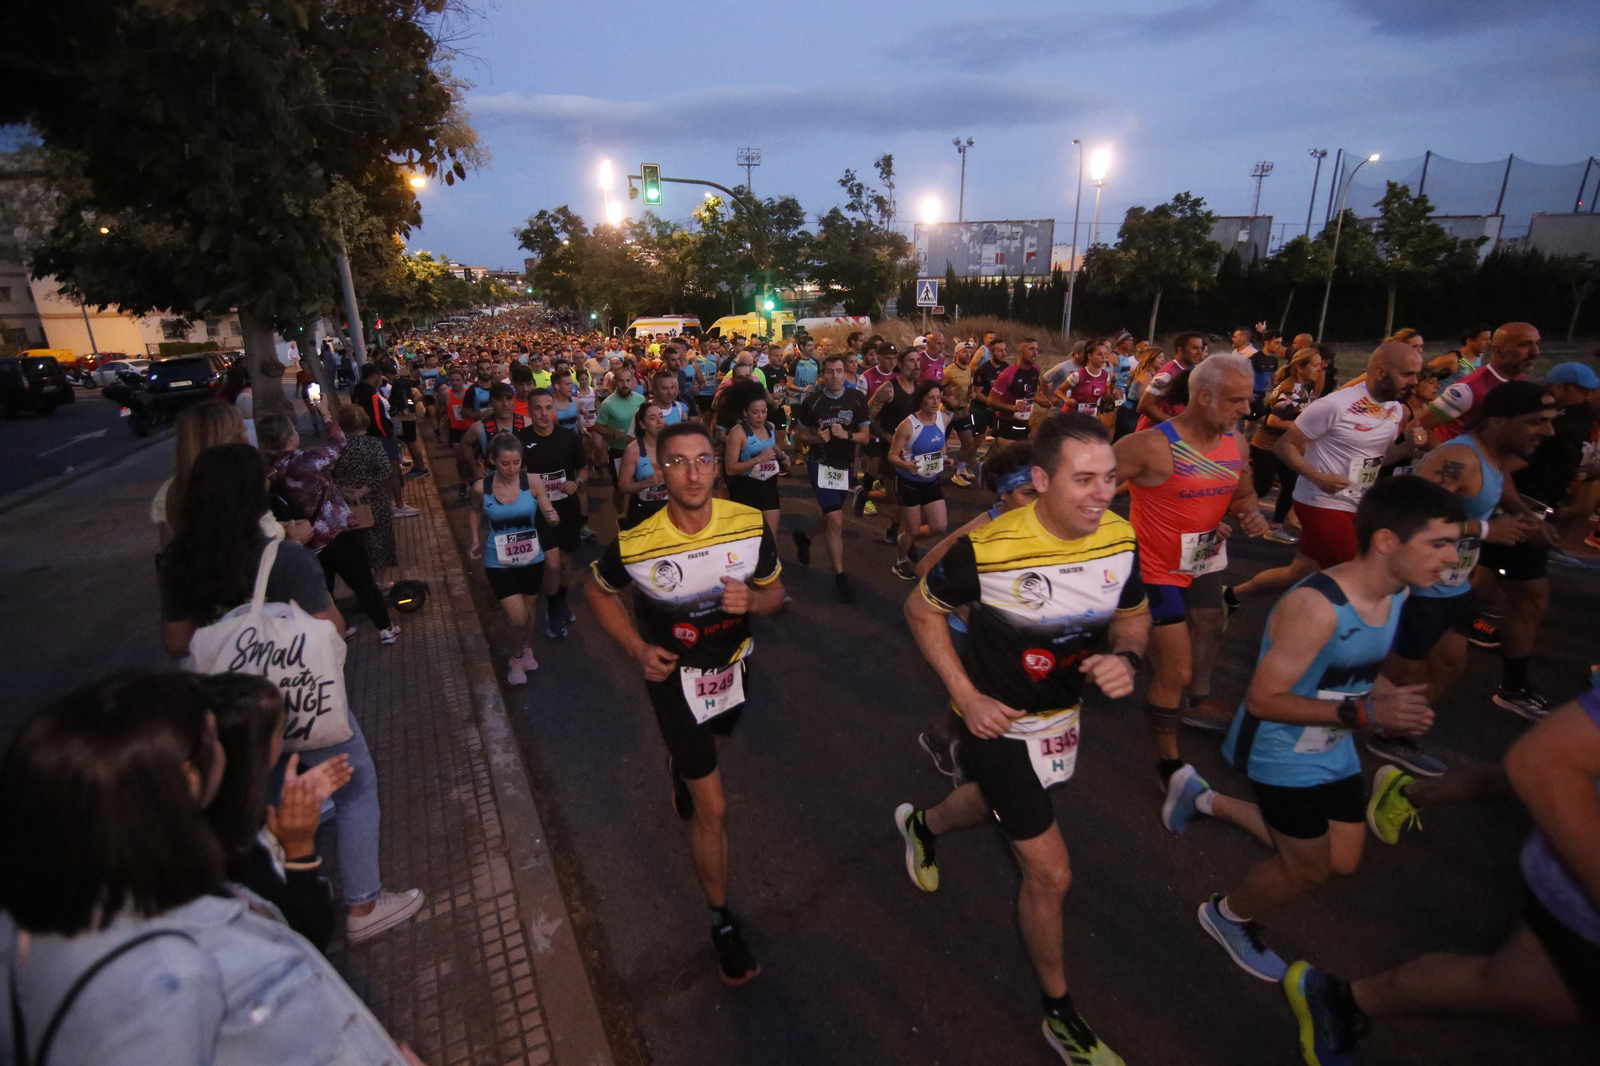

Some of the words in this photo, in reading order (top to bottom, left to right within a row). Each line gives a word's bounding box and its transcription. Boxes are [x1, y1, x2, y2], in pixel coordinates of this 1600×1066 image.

[759, 463, 776, 472] 1995
[925, 462, 938, 471] 757
[827, 471, 842, 480] 529
[508, 534, 517, 543] 21
[506, 543, 533, 556] 1202
[687, 550, 710, 560] FASTER
[229, 626, 306, 677] Small
[279, 668, 323, 691] acts
[697, 673, 734, 697] 1249
[284, 680, 335, 717] NGE
[1042, 727, 1078, 756] 1345
